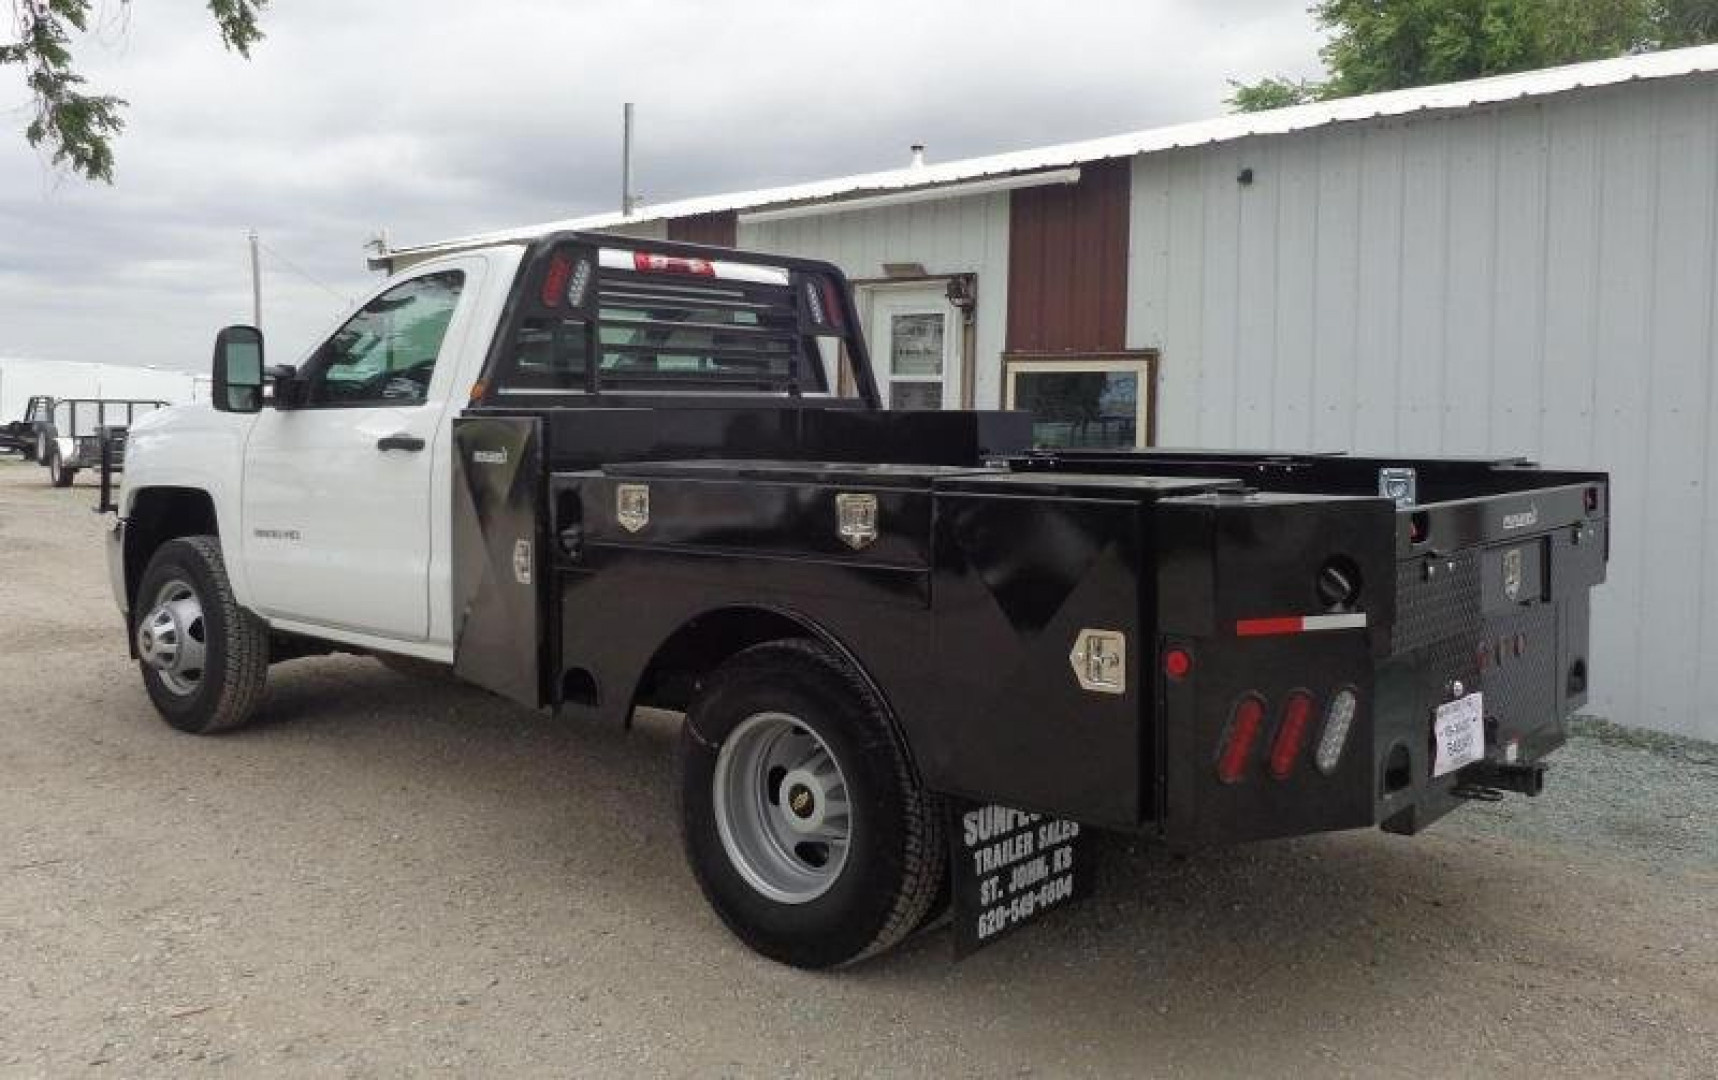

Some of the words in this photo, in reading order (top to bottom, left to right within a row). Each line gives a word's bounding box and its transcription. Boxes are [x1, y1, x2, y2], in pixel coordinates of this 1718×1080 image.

[974, 831, 1034, 876] TRAILER
[1039, 819, 1079, 849] SALES
[980, 875, 1004, 906] ST.
